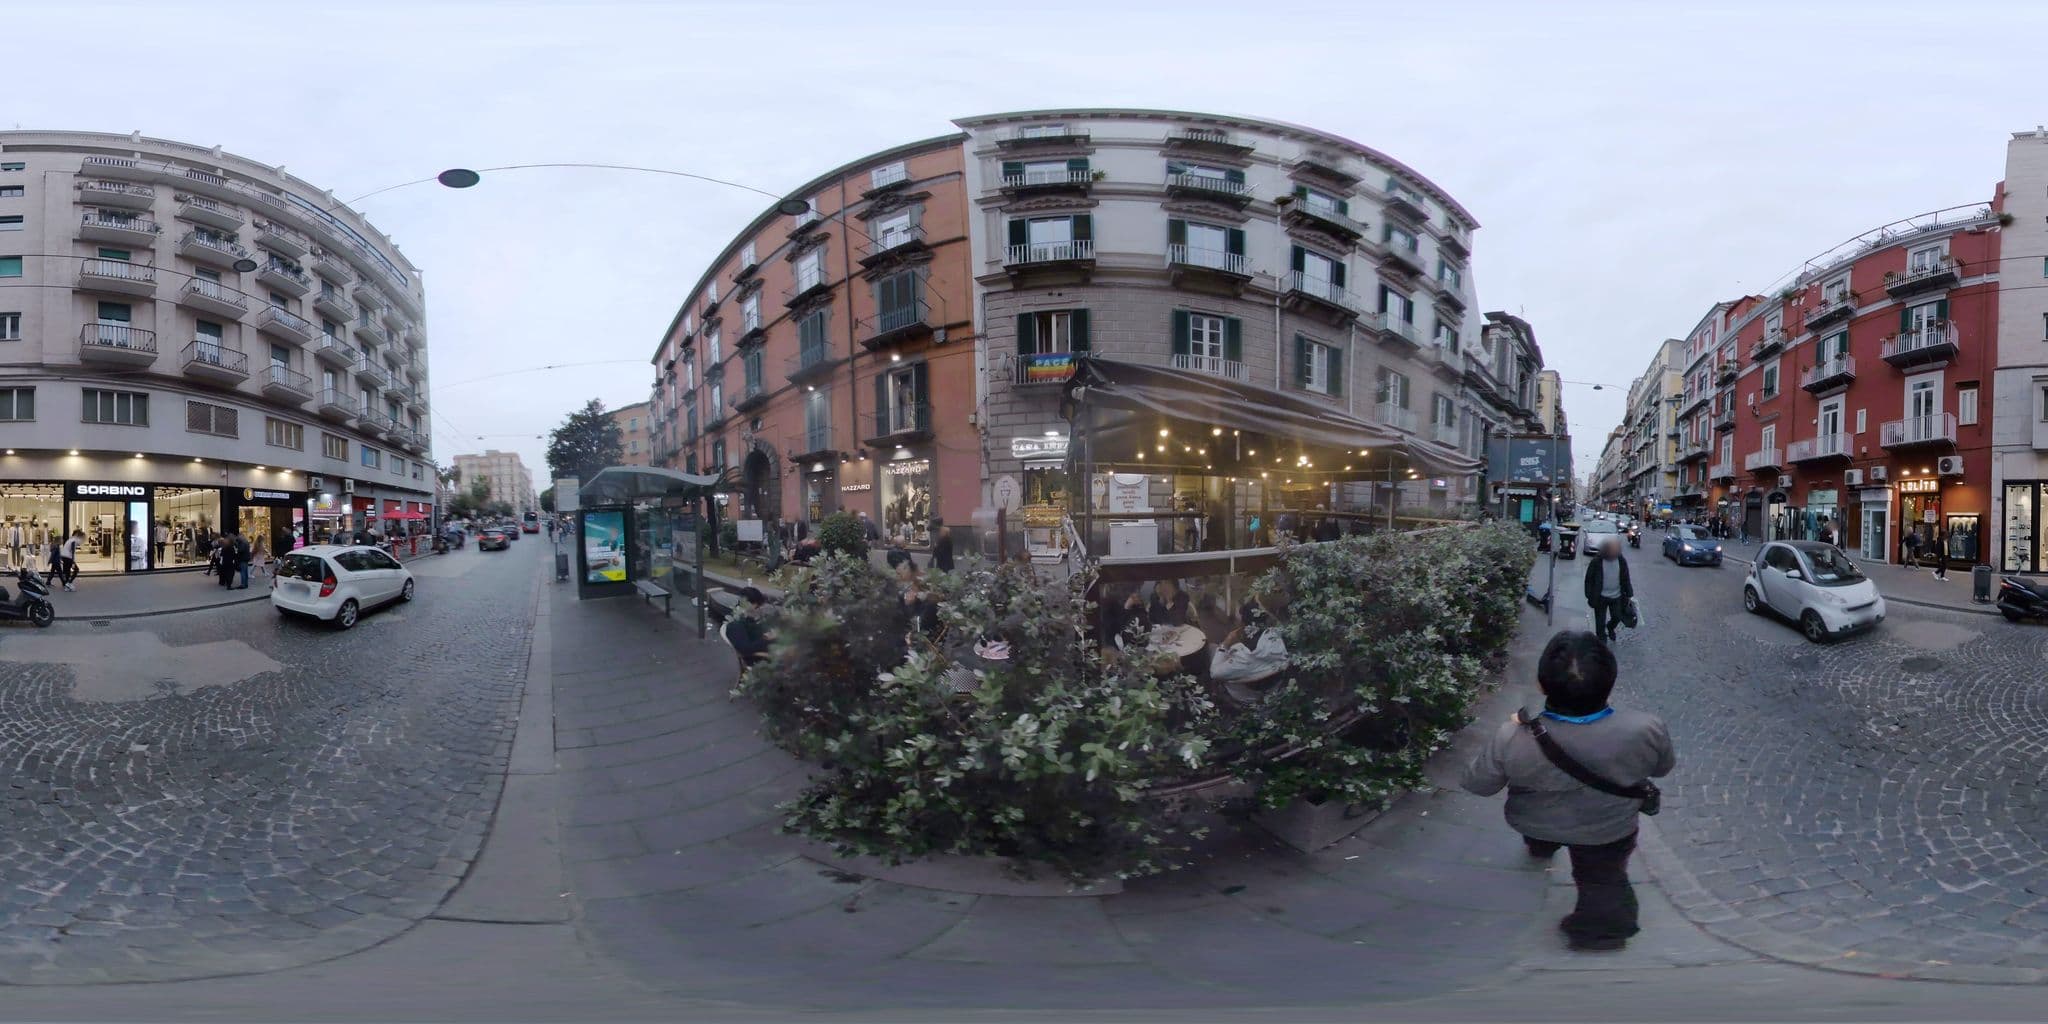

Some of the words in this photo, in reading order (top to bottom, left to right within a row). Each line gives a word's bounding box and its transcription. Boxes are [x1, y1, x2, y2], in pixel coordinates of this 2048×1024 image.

[1036, 358, 1069, 367] PACE
[77, 485, 145, 496] SORBINO
[1901, 480, 1936, 491] LOLITA
